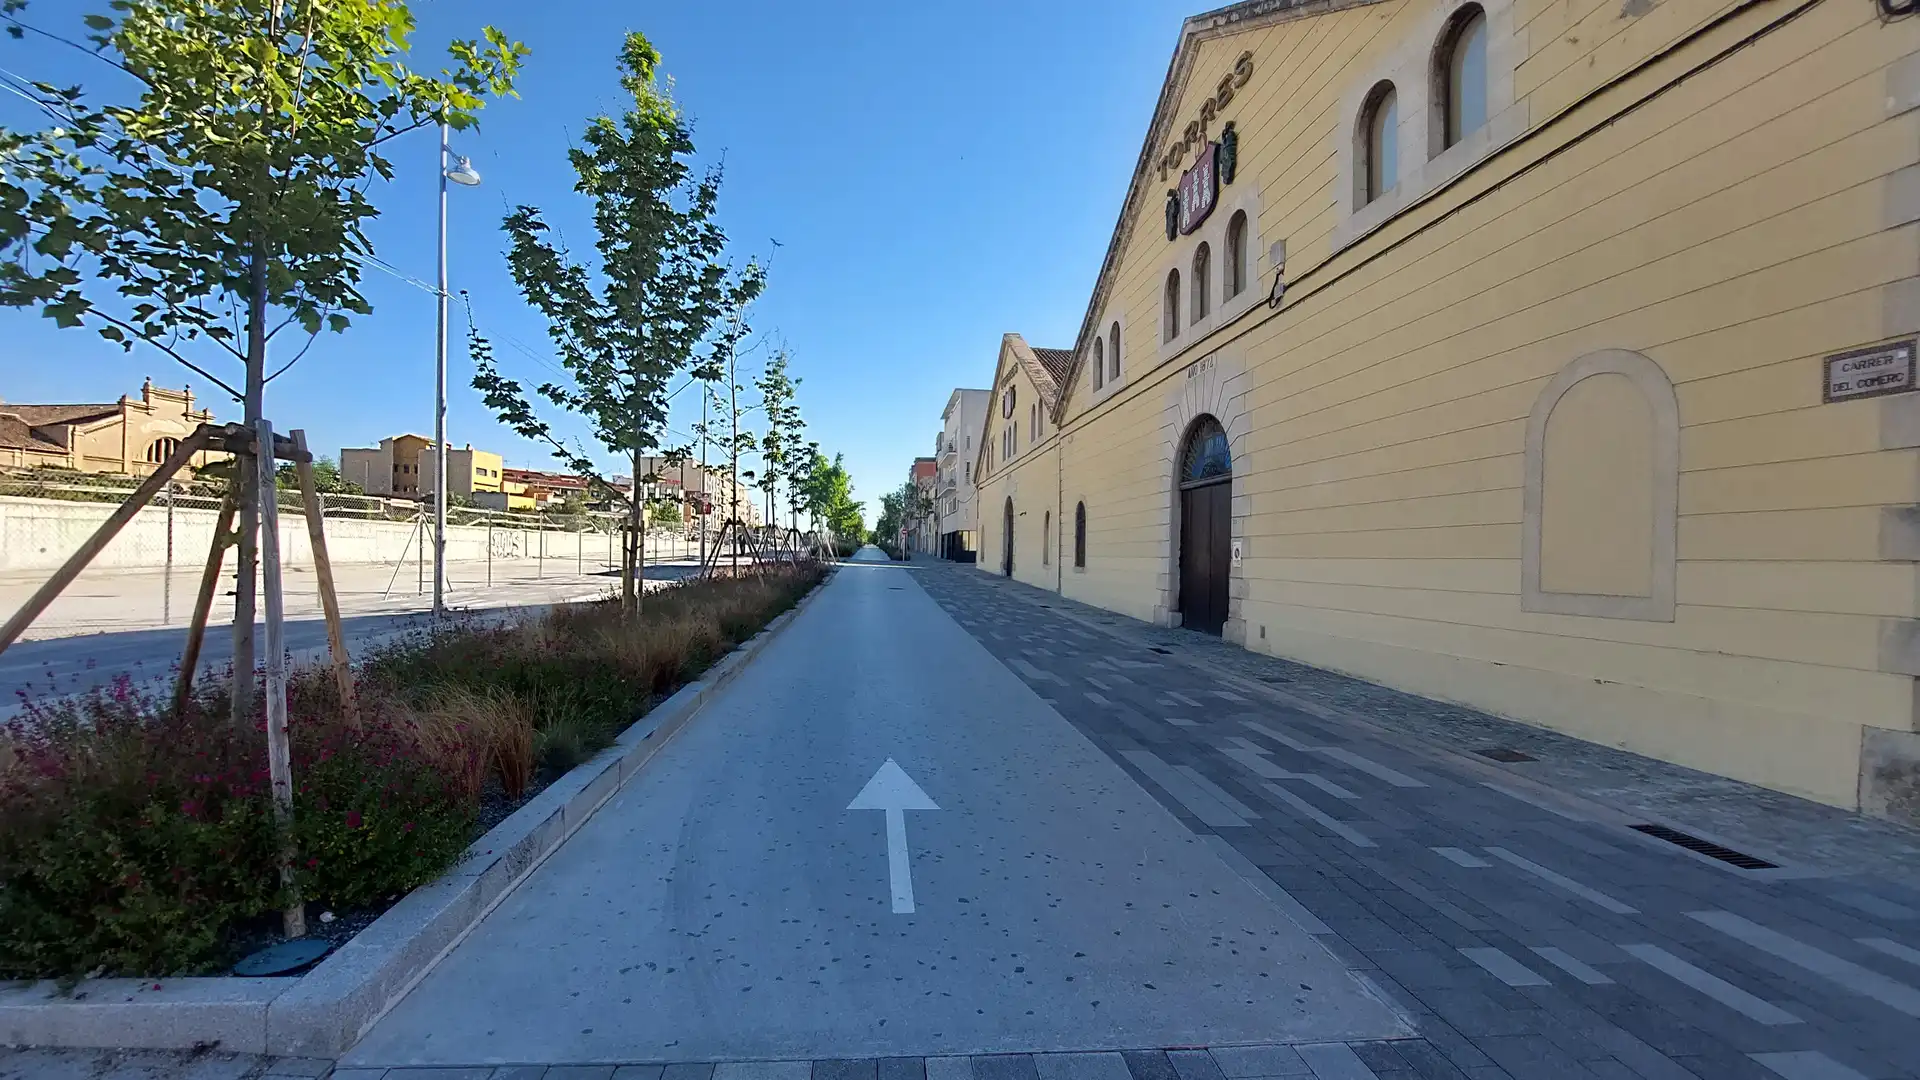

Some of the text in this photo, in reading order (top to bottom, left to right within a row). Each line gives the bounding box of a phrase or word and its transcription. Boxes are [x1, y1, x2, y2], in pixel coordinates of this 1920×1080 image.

[1156, 50, 1254, 182] TORRES
[1842, 355, 1894, 372] CARRER
[1833, 382, 1852, 393] DEL
